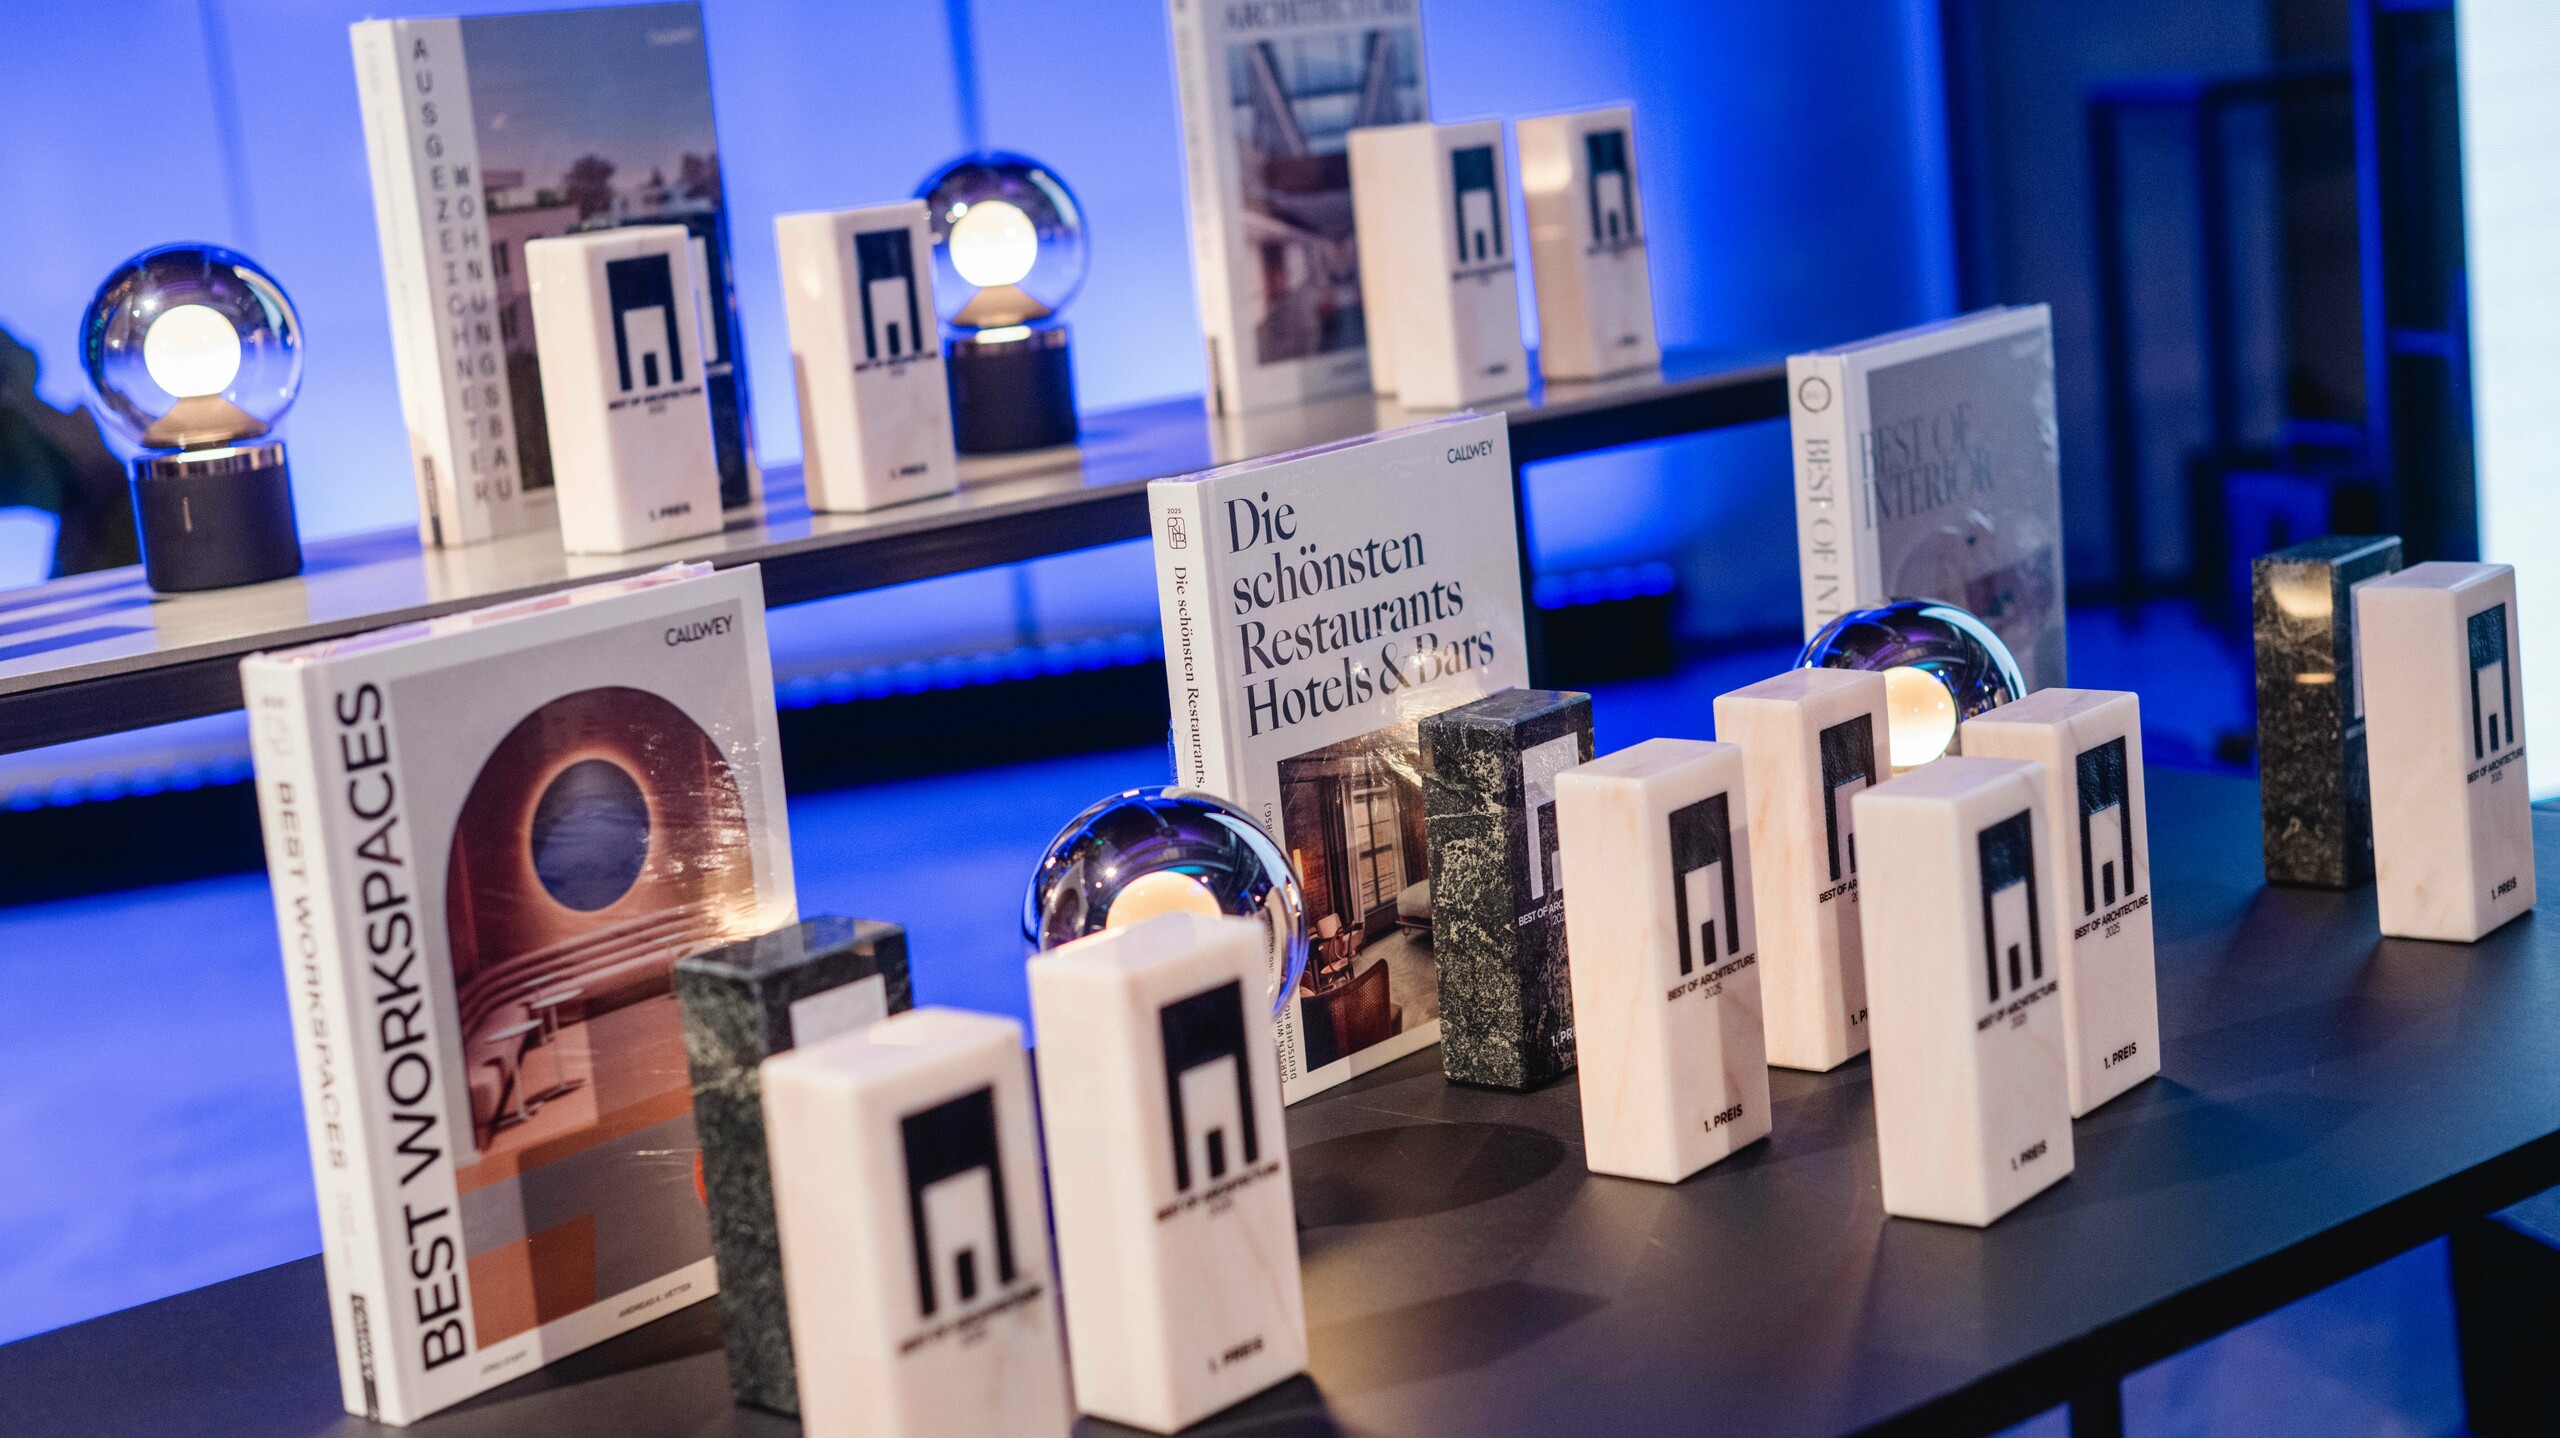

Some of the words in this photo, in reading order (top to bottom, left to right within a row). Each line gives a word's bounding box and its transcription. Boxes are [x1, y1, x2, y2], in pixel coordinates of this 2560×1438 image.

[1446, 439, 1494, 464] CALLWEY
[1806, 438, 1835, 509] BEST
[1166, 507, 1182, 515] 2025
[1223, 491, 1298, 554] Die
[1812, 517, 1838, 563] OF
[1174, 565, 1187, 594] Die
[1233, 532, 1427, 616] schönsten
[664, 614, 733, 647] CALLWEY
[1178, 599, 1195, 683] schönsten
[1237, 580, 1464, 677] Restaurants
[1243, 657, 1374, 738] Hotels
[1412, 630, 1495, 687] Bars
[2467, 769, 2480, 784] BEST
[2480, 765, 2488, 778] OF
[2488, 747, 2524, 772] ARCHITECTURE
[1819, 887, 1836, 903] BEST
[1837, 882, 1847, 895] OF
[2491, 889, 2497, 900] 1.
[2498, 877, 2517, 897] PREIS
[1518, 910, 1537, 926] BEST
[1537, 905, 1548, 918] OF
[1552, 911, 1565, 925] 202
[2074, 922, 2090, 940] BEST
[2091, 917, 2101, 931] OF
[2101, 894, 2149, 926] ARCHITECTURE
[2105, 922, 2121, 938] 2025
[336, 682, 442, 1187] WORKSPACES
[275, 781, 308, 876] BEST
[295, 897, 348, 1169] WORKSPACES
[1667, 985, 1686, 1001] BEST
[1687, 978, 1698, 994] OF
[1700, 953, 1756, 987] ARCHITECTURE
[1704, 982, 1722, 999] 2025
[1851, 1013, 1858, 1026] 1.
[1285, 1022, 1297, 1080] DEUTSCHER
[1550, 1034, 1558, 1047] 1.
[2104, 1056, 2111, 1069] 1.
[2112, 1042, 2137, 1065] PREIS
[1279, 1040, 1289, 1084] CARSTEN
[1703, 1120, 1711, 1133] 1.
[1714, 1103, 1743, 1128] PREIS
[404, 1202, 467, 1374] BEST
